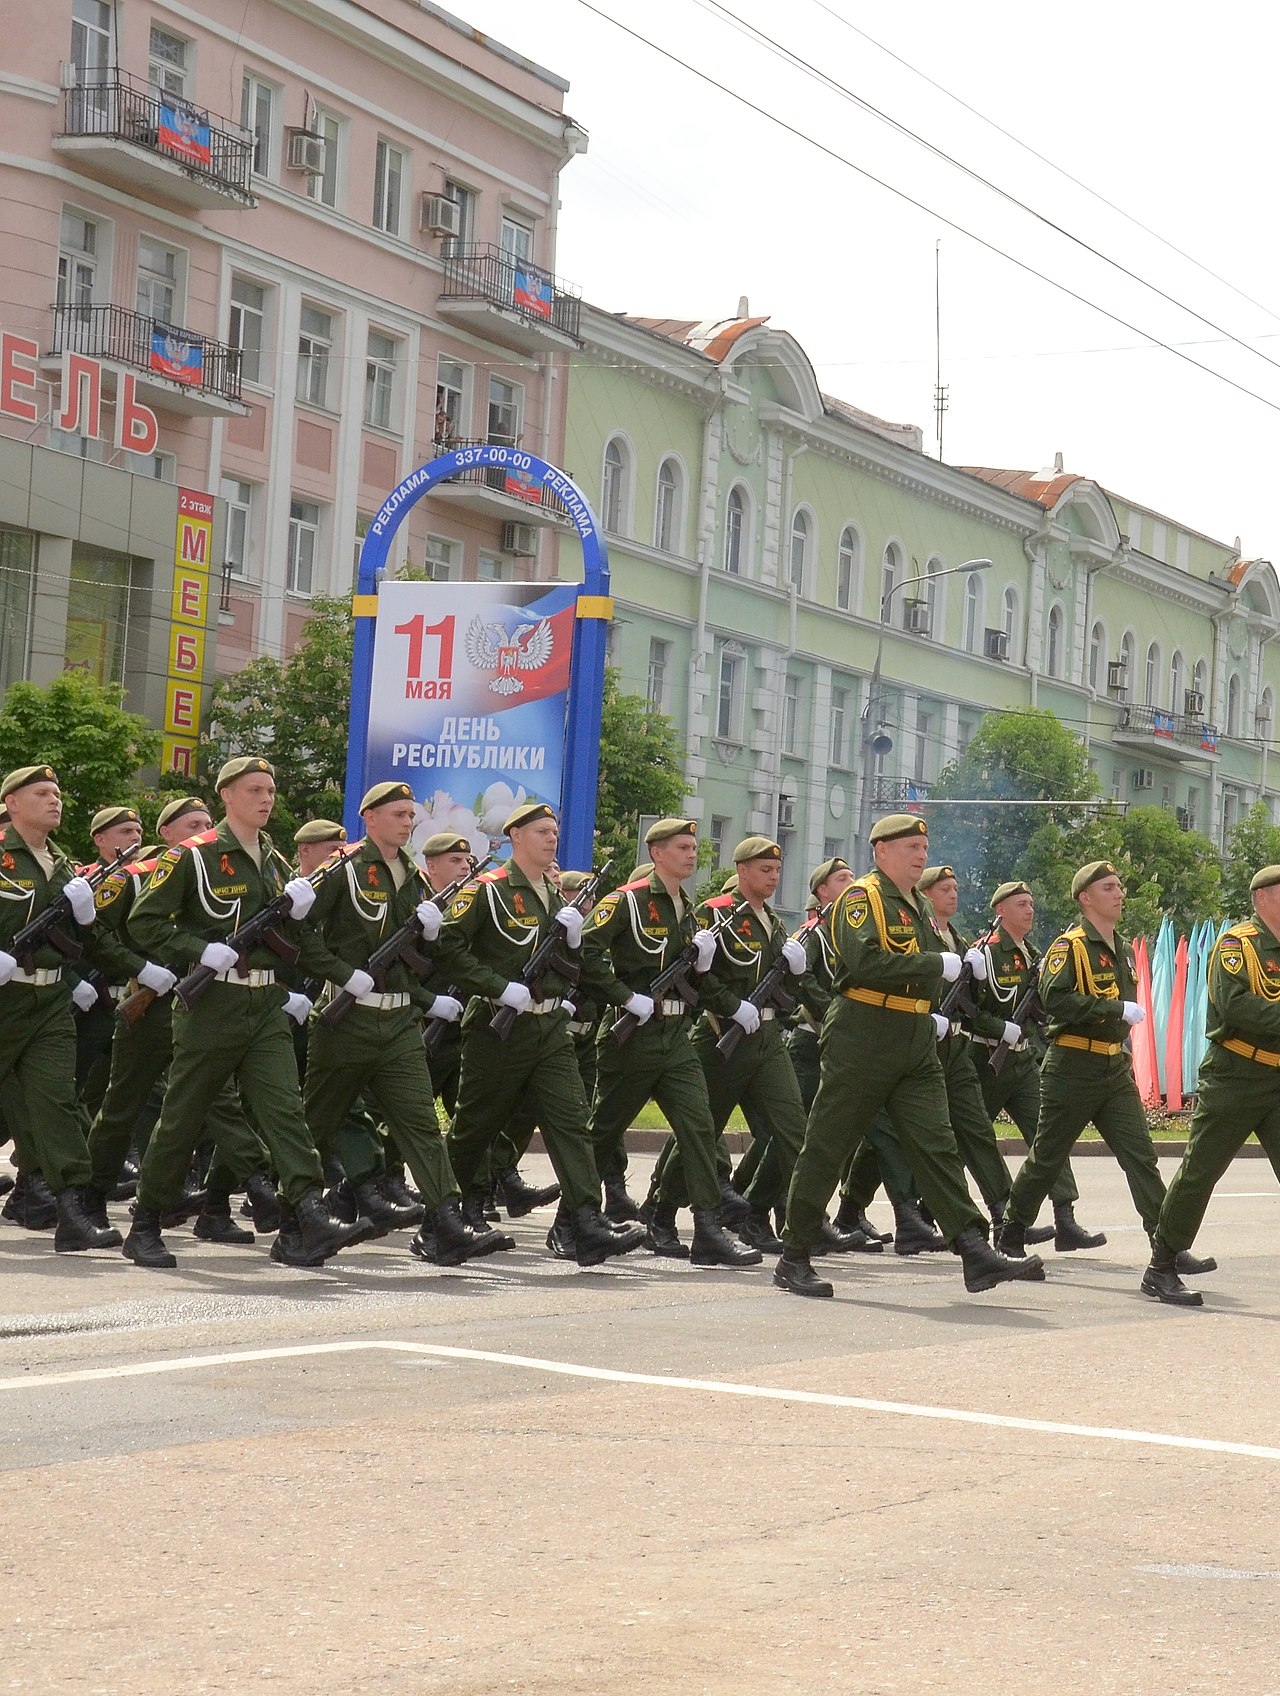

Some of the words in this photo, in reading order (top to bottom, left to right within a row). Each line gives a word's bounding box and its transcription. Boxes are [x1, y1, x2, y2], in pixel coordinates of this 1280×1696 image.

[0, 331, 158, 456] ЕЛЬ
[455, 448, 532, 470] 337-00-00
[180, 496, 187, 509] 2
[188, 500, 212, 515] этаж
[372, 469, 431, 537] РЕКЛАМА
[542, 467, 593, 539] РЕКЛАМА
[394, 614, 456, 679] 11
[405, 680, 452, 700] мая
[439, 716, 501, 744] ДЕНЬ
[392, 743, 545, 770] РЕСПУБЛИКИ
